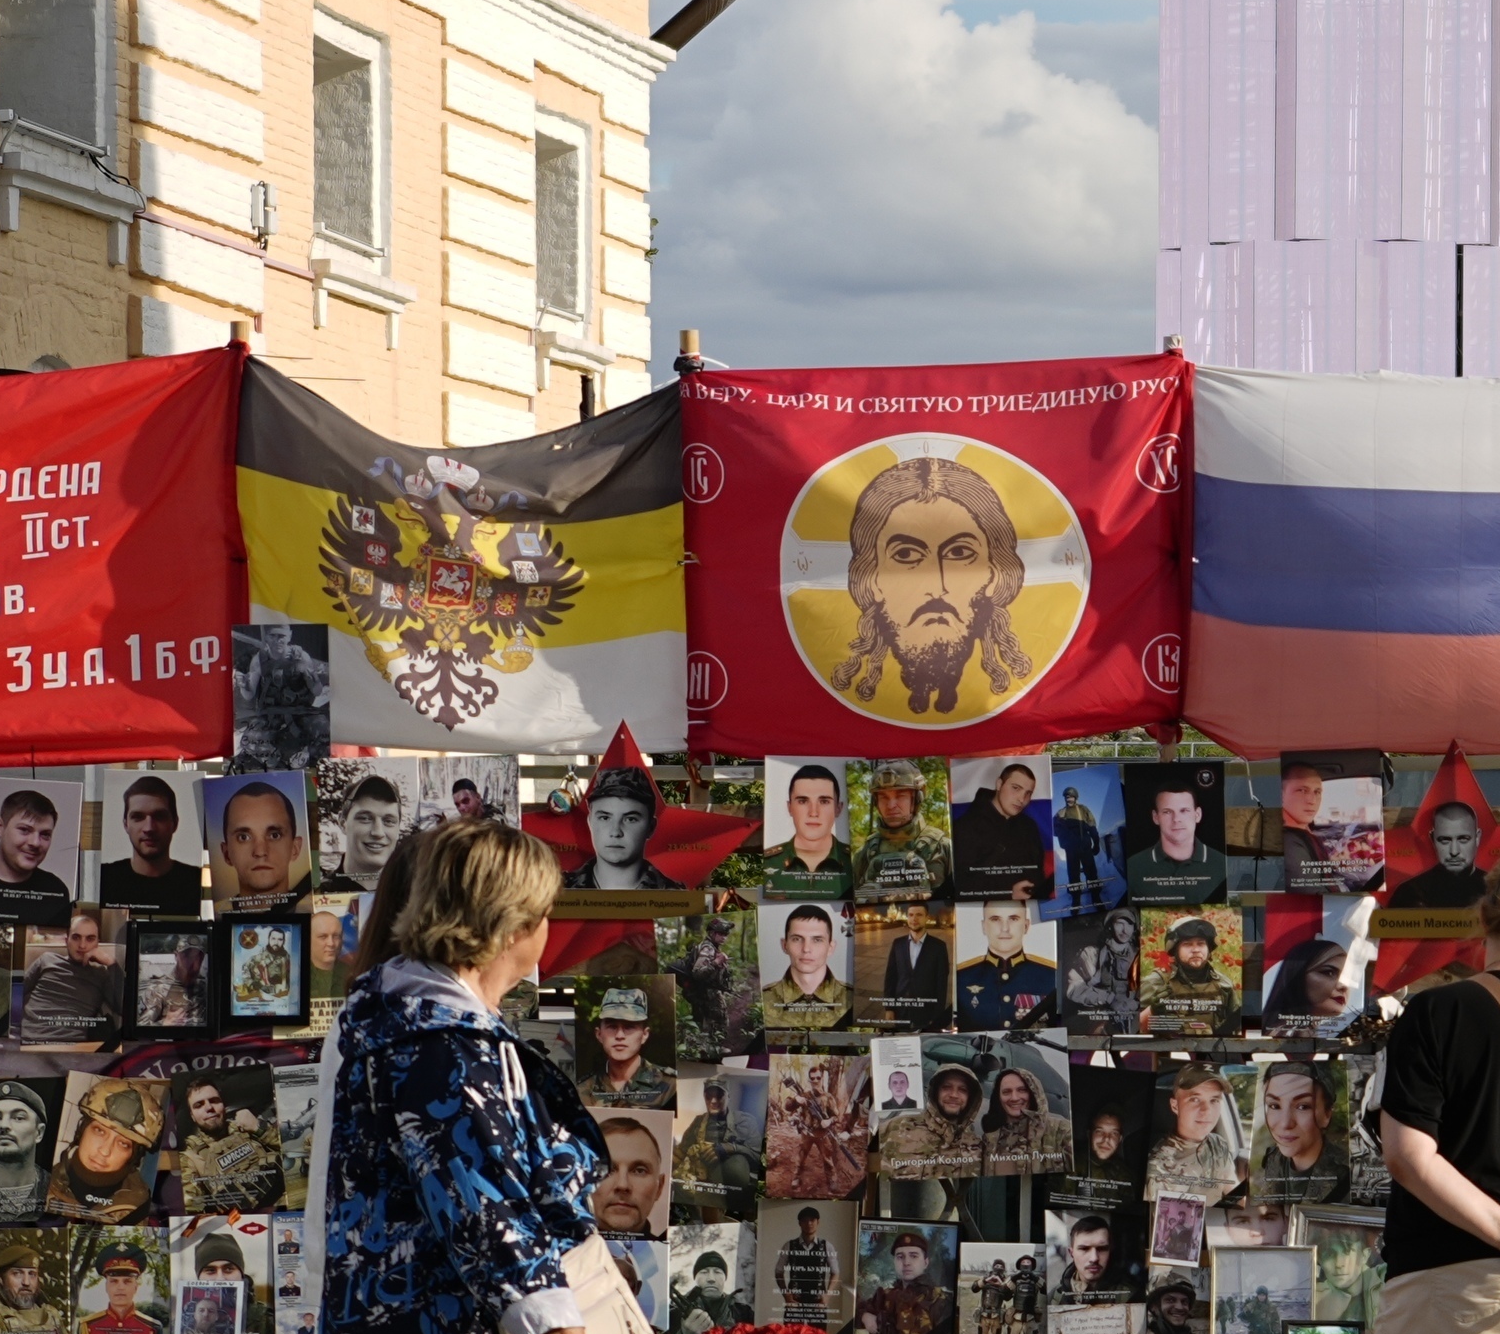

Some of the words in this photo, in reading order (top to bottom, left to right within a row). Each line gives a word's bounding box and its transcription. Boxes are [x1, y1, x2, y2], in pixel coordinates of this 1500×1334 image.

[766, 392, 830, 410] ЦАРЯ
[834, 396, 855, 414] И
[858, 395, 963, 414] СВЯТУЮ
[967, 382, 1128, 417] ТРИЕДИНУЮ
[581, 897, 647, 910] Александрович
[648, 899, 691, 910] Родионов
[1377, 917, 1421, 929] Фомин
[1423, 917, 1473, 929] Максим
[218, 1141, 253, 1168] КАРЛССОН
[889, 1156, 936, 1169] Григорий
[938, 1154, 974, 1166] Козлов
[989, 1151, 1029, 1163] Михаил
[1031, 1150, 1063, 1162] Лучин
[85, 1193, 114, 1207] Фокус
